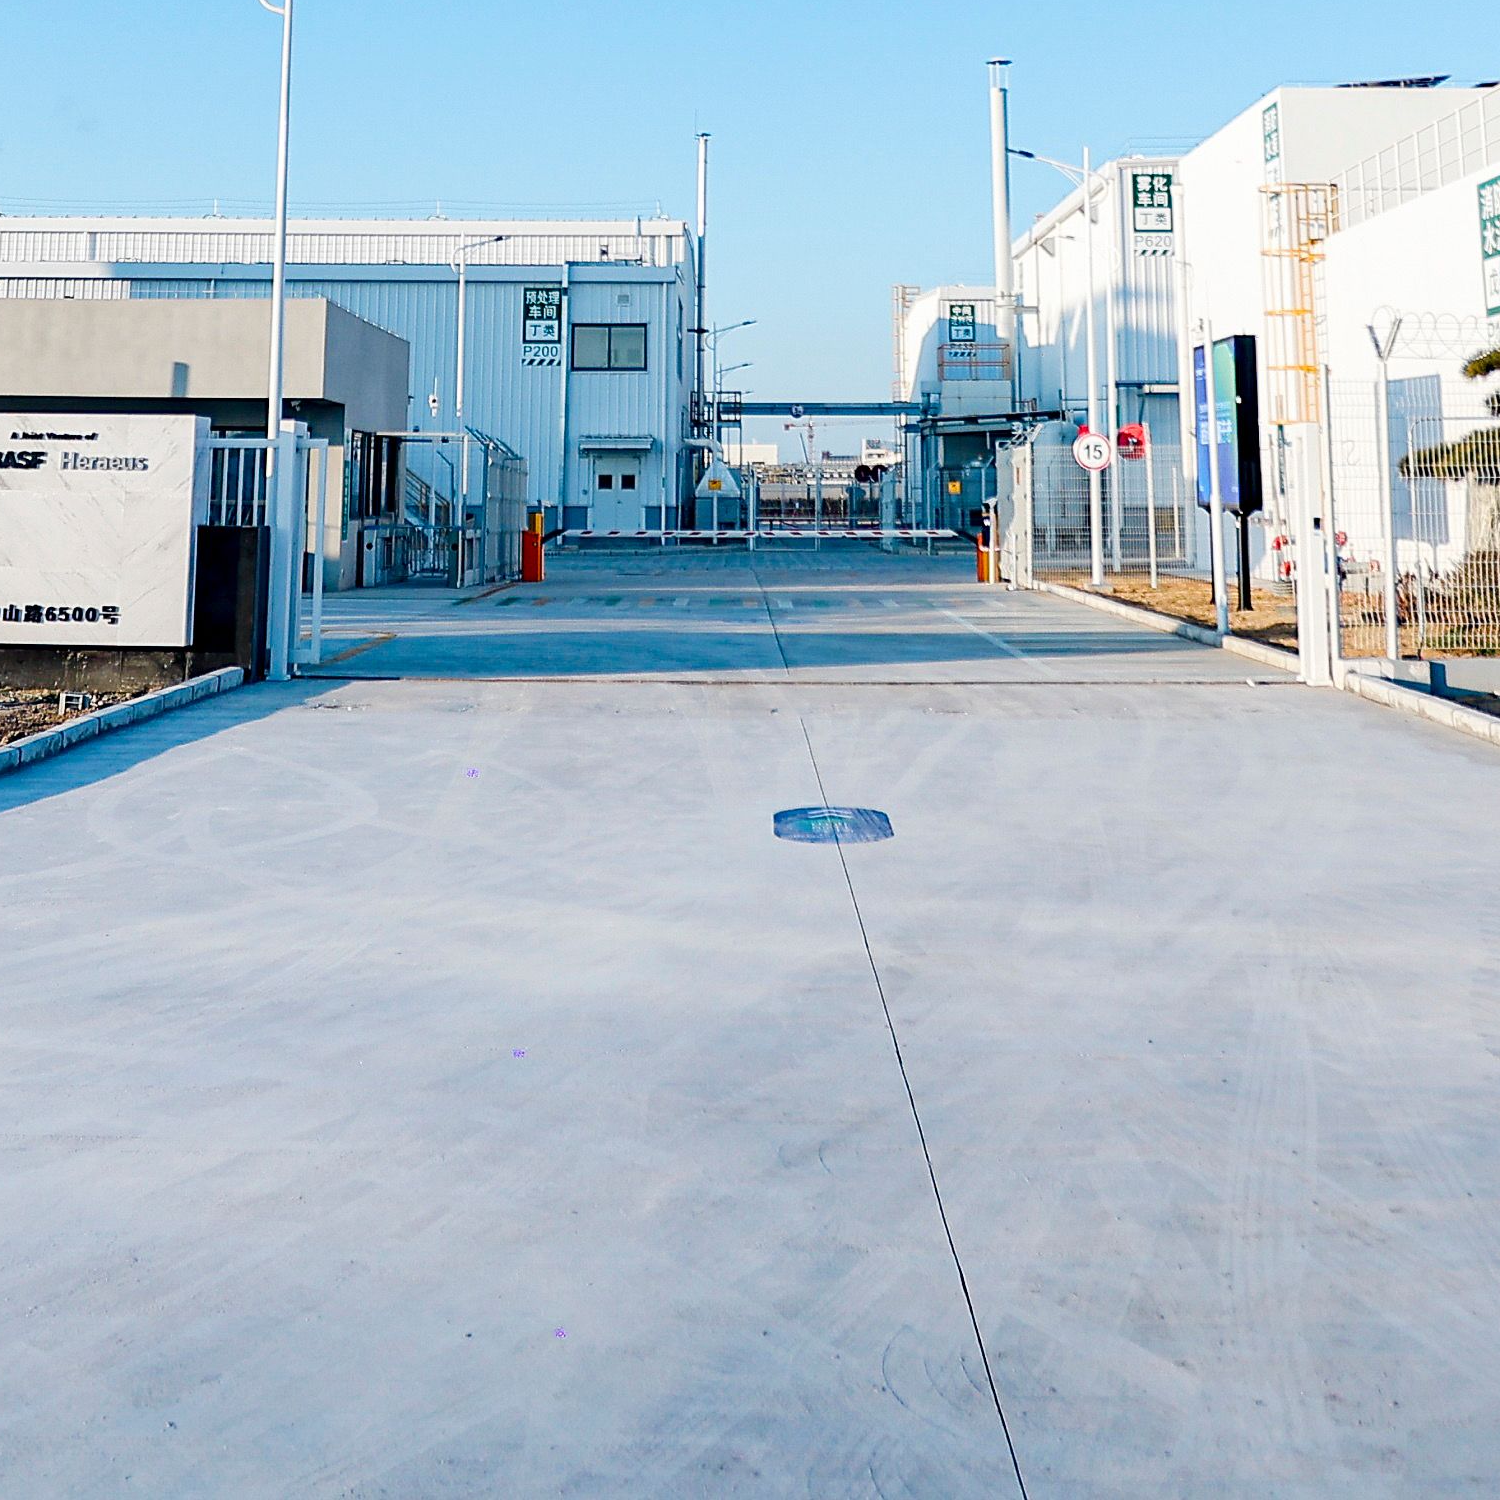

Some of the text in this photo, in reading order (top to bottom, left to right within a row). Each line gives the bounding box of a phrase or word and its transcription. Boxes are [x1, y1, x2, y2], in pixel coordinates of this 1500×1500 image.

[1137, 191, 1169, 207] 车间
[1135, 236, 1172, 247] P620
[526, 291, 560, 305] 预处理
[528, 305, 557, 319] 车间
[530, 324, 555, 337] 丁类
[523, 346, 559, 357] P200
[1084, 444, 1103, 460] 15
[60, 451, 148, 470] Heraeus
